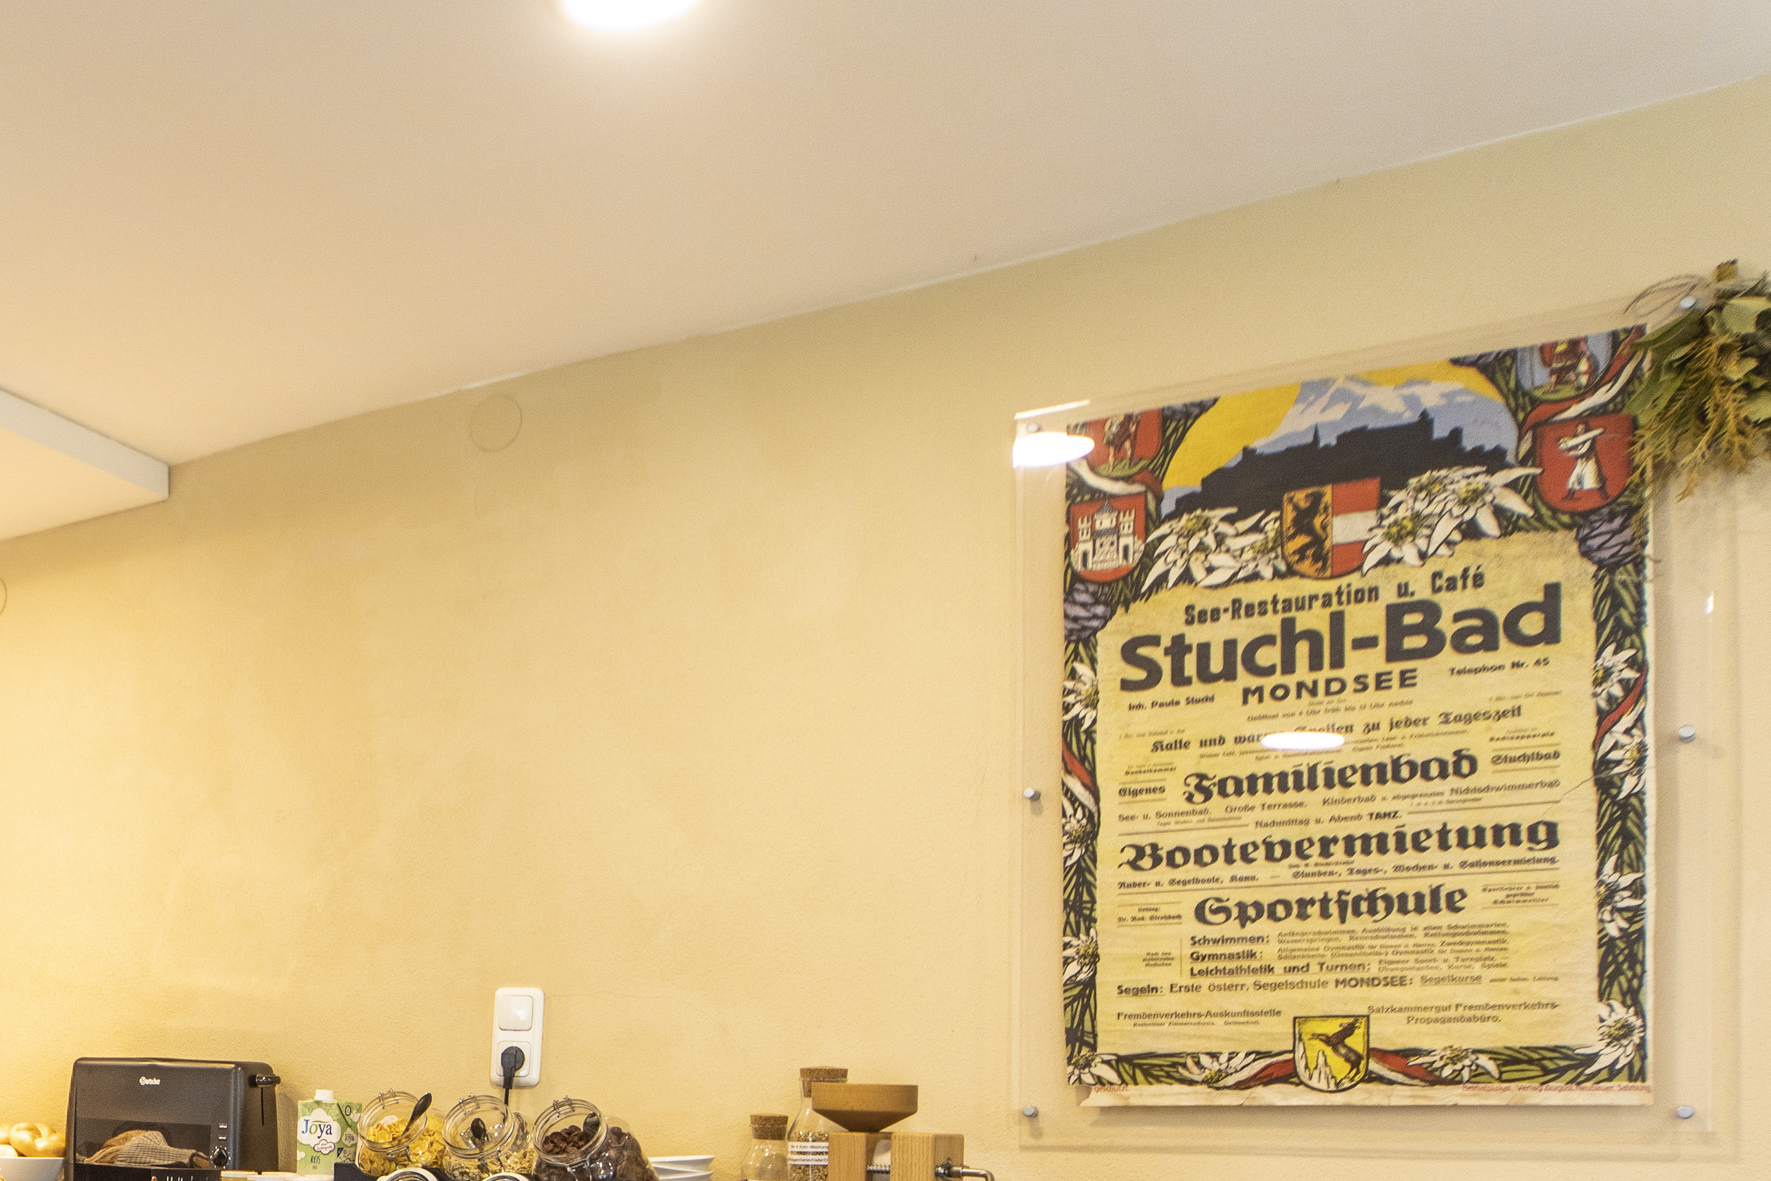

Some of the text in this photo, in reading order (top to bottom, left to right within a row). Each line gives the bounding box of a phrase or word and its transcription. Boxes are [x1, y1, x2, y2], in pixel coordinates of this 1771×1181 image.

[1184, 565, 1486, 626] See-Restauration u. Café
[1120, 581, 1562, 692] Stuchl-Bad
[1449, 663, 1505, 677] Telephon
[1241, 668, 1418, 706] MONDSEE
[1128, 702, 1147, 711] Inh.
[1185, 694, 1215, 705] Stuchl
[1151, 738, 1191, 753] Kalte
[1199, 735, 1226, 748] und
[1363, 722, 1381, 735] zu
[1389, 715, 1430, 732] jeder
[1438, 704, 1522, 726] Tageszeit
[1491, 750, 1561, 765] Stuchlbad
[1183, 748, 1479, 805] Familienbad
[1118, 785, 1166, 798] Eigenes
[1224, 804, 1256, 813] Große
[1260, 801, 1307, 811] Terrasse.
[1322, 794, 1377, 807] Kinderbad
[1255, 816, 1310, 829] Nachmittag
[1329, 813, 1363, 823] Abend
[1368, 810, 1402, 820] TANZ.
[1118, 819, 1560, 872] Bootevermietung
[1194, 883, 1468, 929] Sportschule
[1190, 934, 1270, 947] Schwimmen:
[1190, 950, 1263, 962] Gymnastik:
[1190, 965, 1275, 977] Leichtathletik
[1284, 962, 1310, 973] und
[1318, 961, 1370, 972] Turnen:
[1117, 984, 1163, 996] Segeln:
[1170, 983, 1202, 993] Erste
[1208, 981, 1249, 992] österr.
[1253, 978, 1329, 992] Segelschule
[1335, 976, 1413, 988] MONDSEE:
[1420, 974, 1482, 985] Segelkurse
[1117, 1009, 1282, 1021] Fremdenverkehrs-Auskunftsstelle
[1367, 1001, 1560, 1014] Salzkammergut Fremdenverkehrs-
[1406, 1014, 1502, 1025] Propagandabüro.
[301, 1118, 333, 1139] Joya
